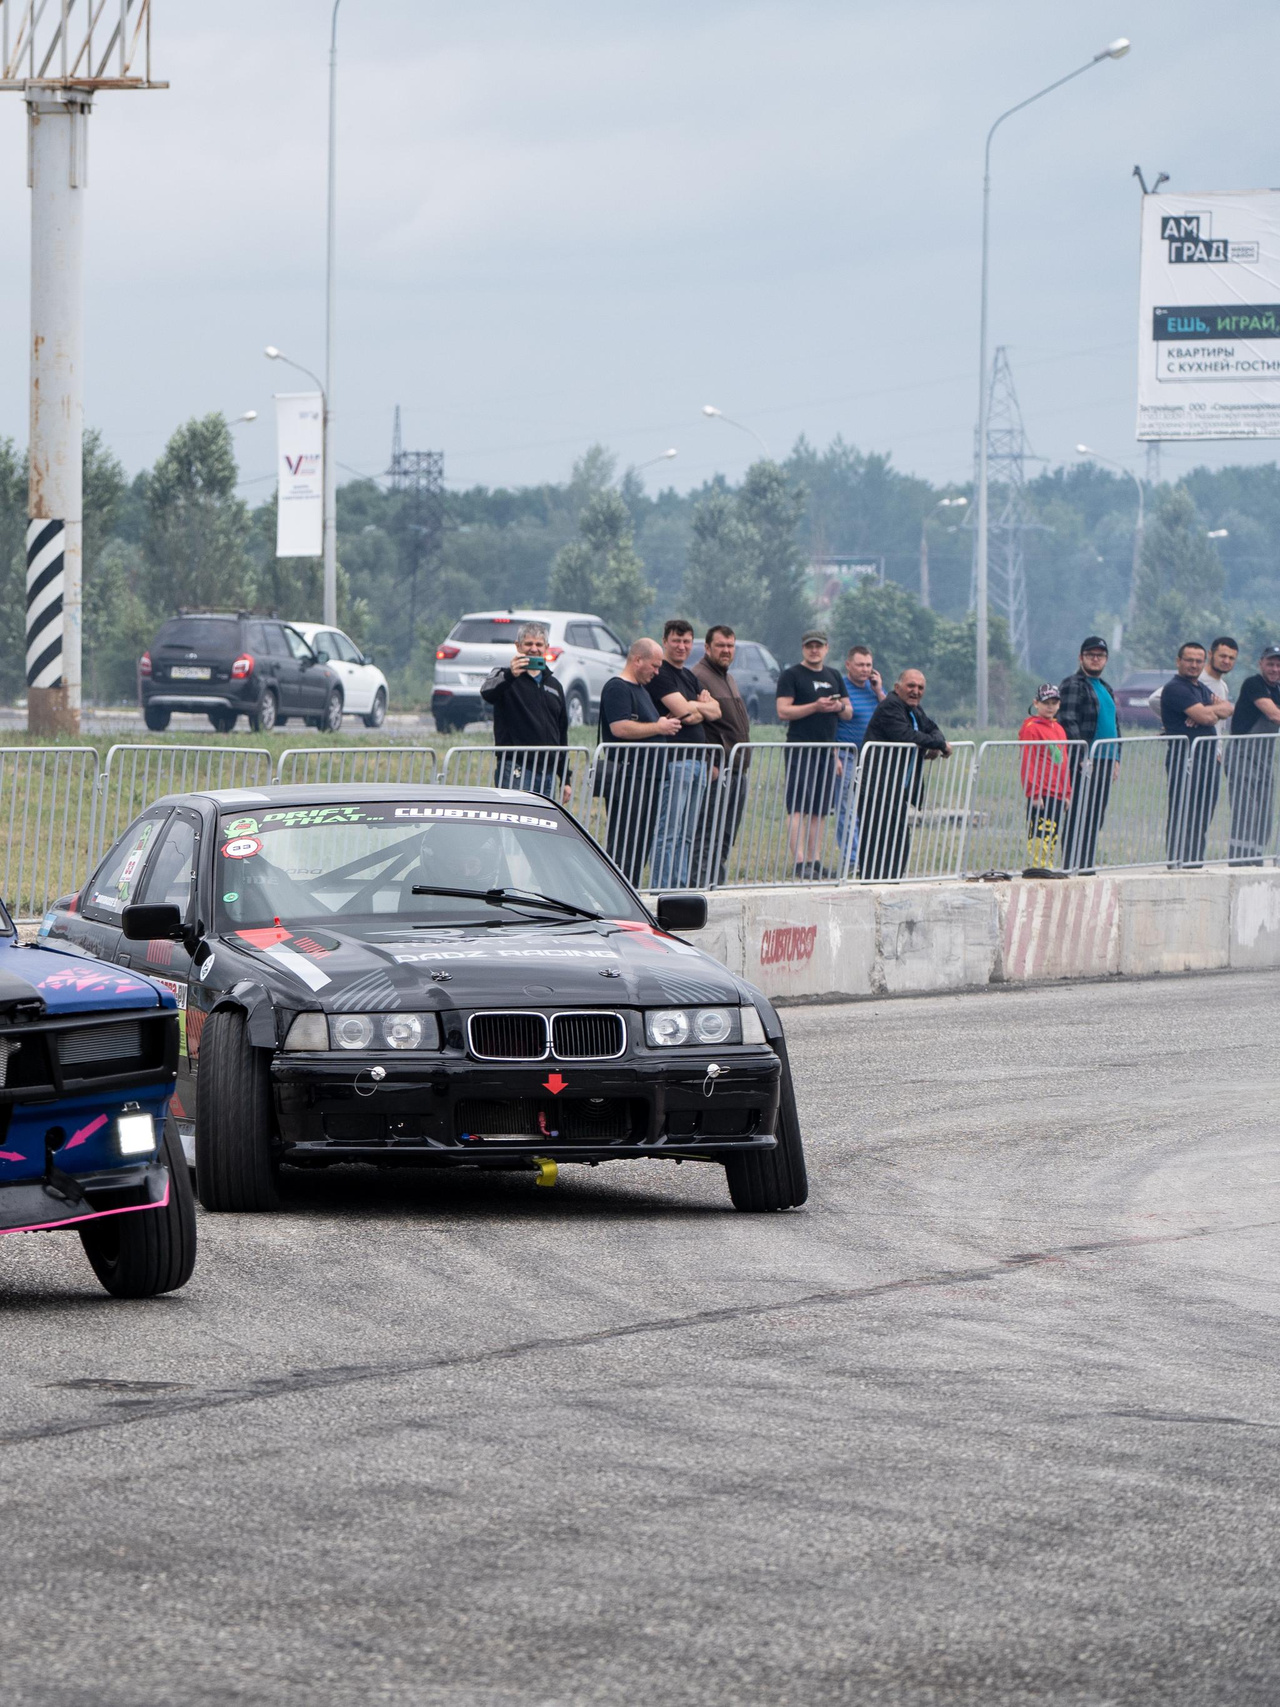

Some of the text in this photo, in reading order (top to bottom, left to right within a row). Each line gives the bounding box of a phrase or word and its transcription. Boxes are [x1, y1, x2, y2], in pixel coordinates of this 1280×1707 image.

[1163, 217, 1199, 239] АМ
[1170, 241, 1227, 262] ГРАД
[1167, 317, 1211, 334] ЕШЬ,
[1167, 347, 1235, 358] КВАРТИРЫ
[1167, 362, 1175, 373] С
[262, 806, 361, 822] DRIFT
[394, 807, 558, 830] CLUBTURBO
[395, 949, 619, 963] DADZ RACING
